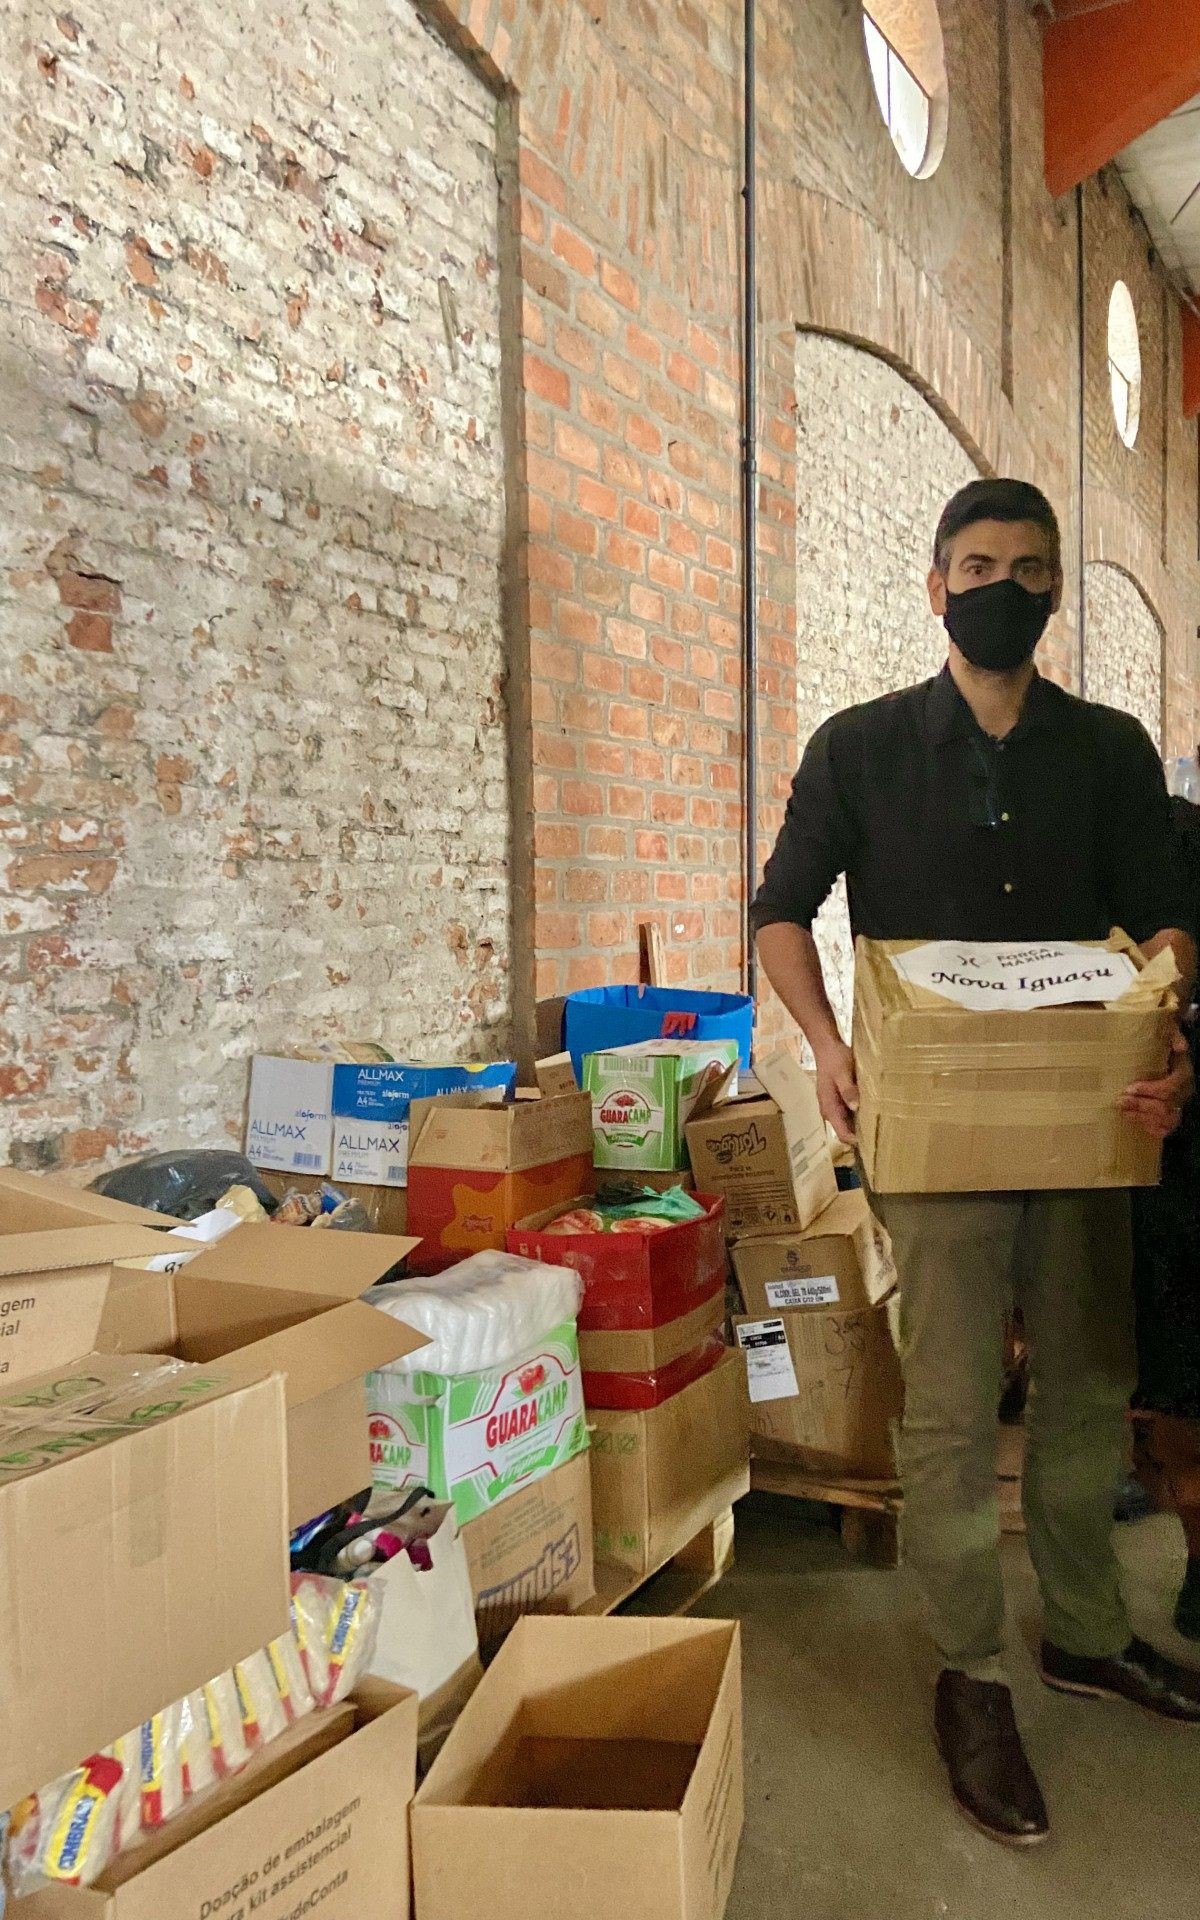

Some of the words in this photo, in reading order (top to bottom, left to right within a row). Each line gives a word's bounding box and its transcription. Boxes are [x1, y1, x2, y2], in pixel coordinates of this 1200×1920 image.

[930, 971, 1008, 991] Nova
[1017, 967, 1114, 992] Iguaçu
[357, 1068, 405, 1082] ALLMAX
[600, 1108, 652, 1125] GUARACAMP
[251, 1119, 307, 1140] ALLMAX
[248, 1144, 262, 1158] A4
[338, 1134, 400, 1154] ALLMAX
[338, 1161, 353, 1175] A4
[0, 1319, 20, 1337] ial
[485, 1379, 569, 1449] GUARACAMP
[200, 1870, 260, 1920] Doação
[262, 1853, 281, 1876] de
[284, 1797, 361, 1862] embalagem
[249, 1887, 268, 1911] kit
[271, 1824, 352, 1897] assistencial
